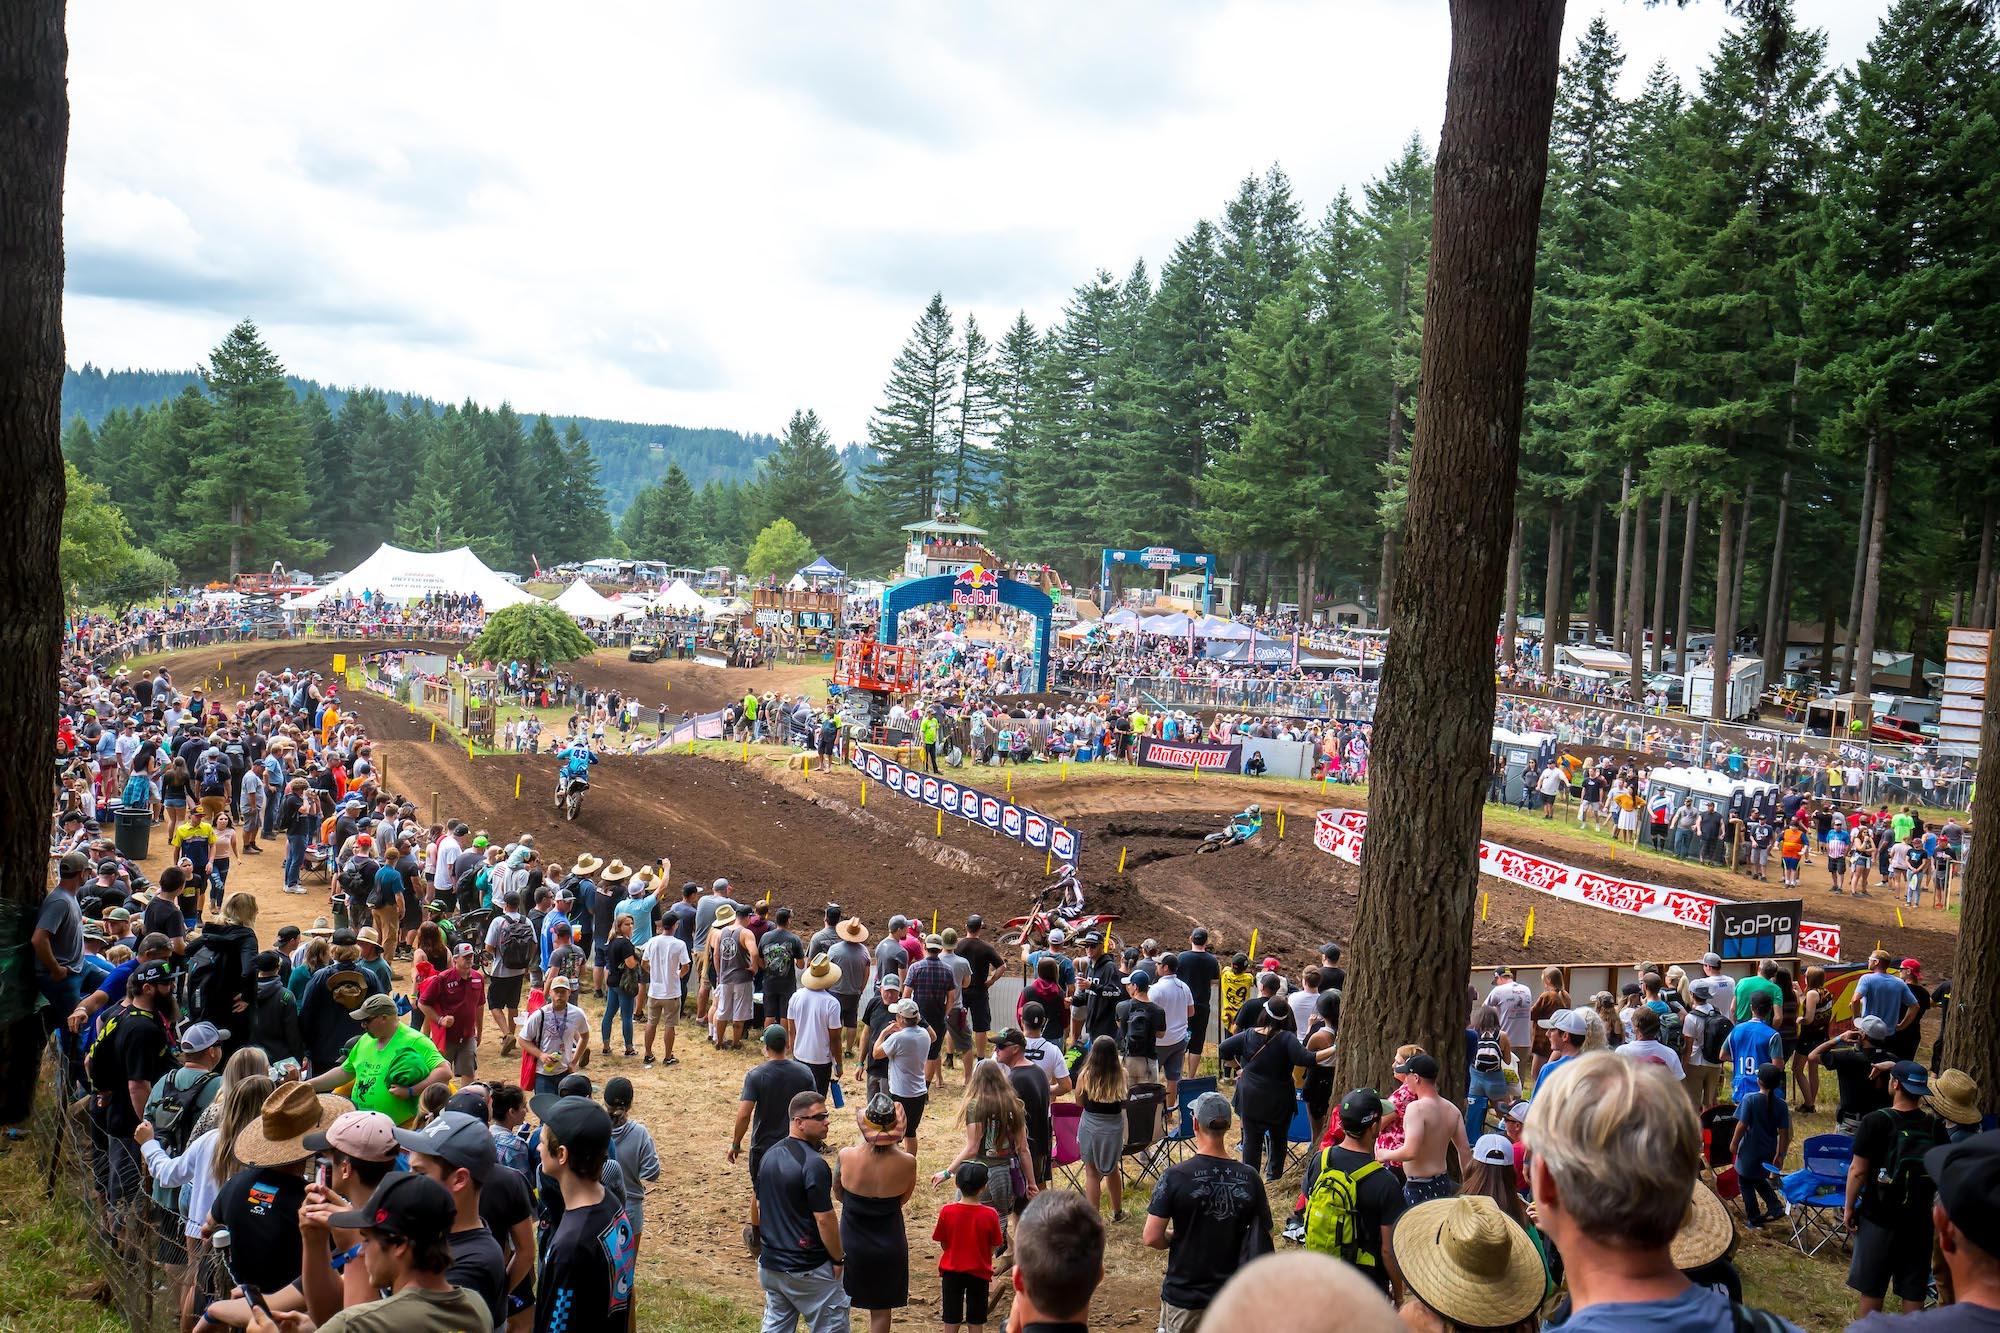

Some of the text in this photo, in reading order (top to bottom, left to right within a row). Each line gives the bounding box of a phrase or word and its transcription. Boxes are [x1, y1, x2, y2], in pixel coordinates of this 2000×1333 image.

[953, 589, 998, 605] Red Bull
[573, 749, 588, 759] 45
[1612, 898, 1637, 910] OUT
[1724, 914, 1791, 936] GoPro
[1740, 1056, 1756, 1075] 19
